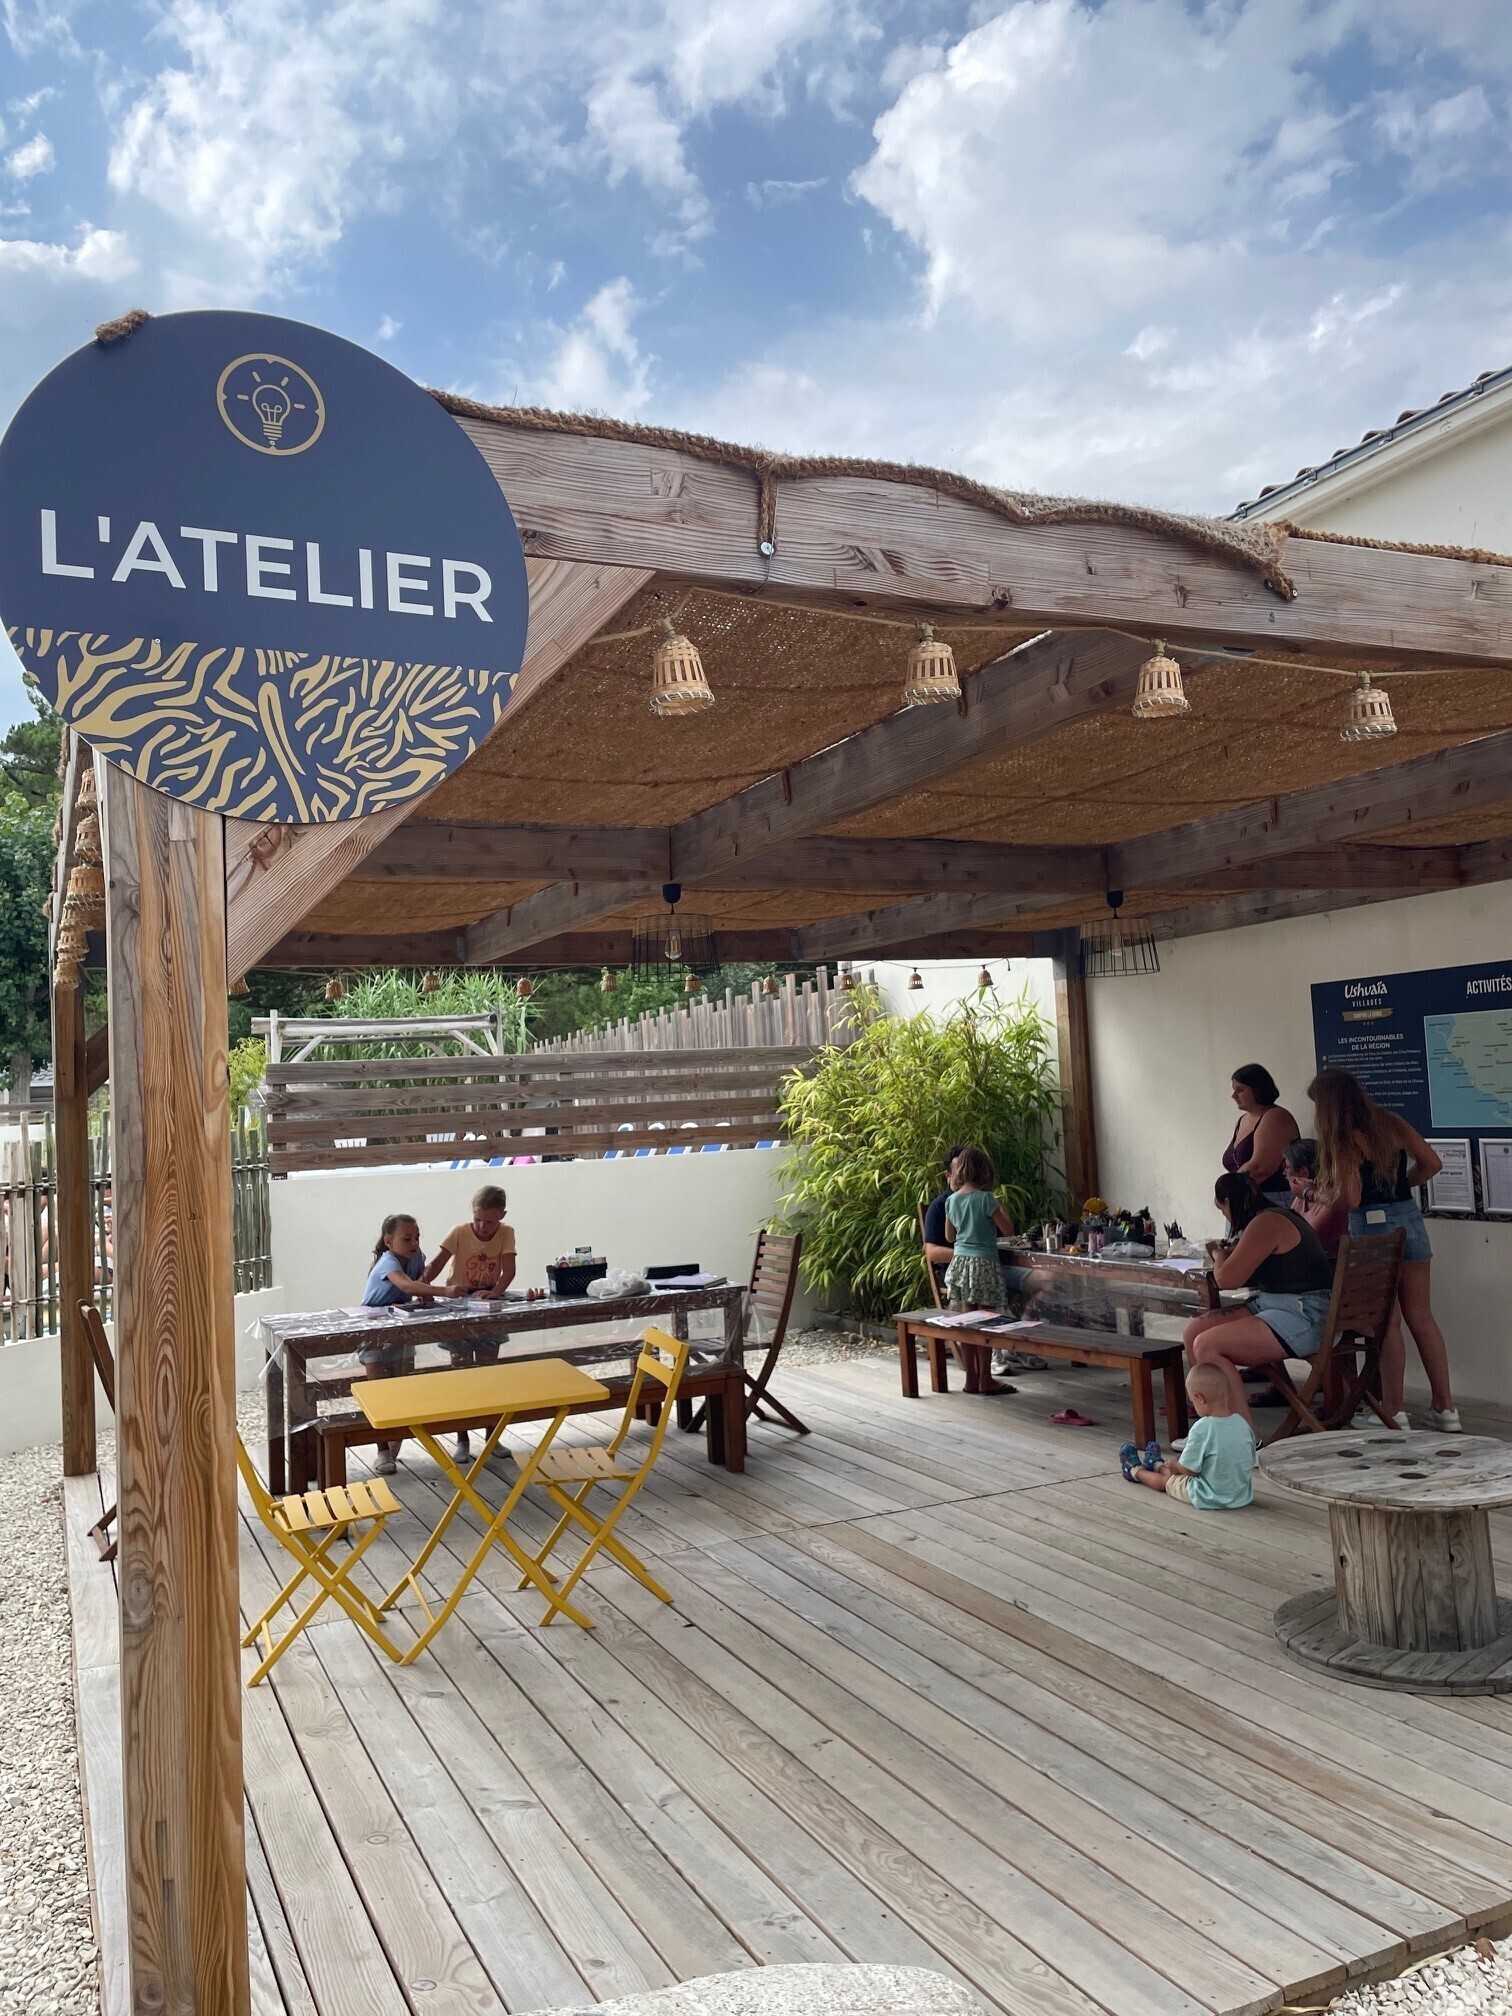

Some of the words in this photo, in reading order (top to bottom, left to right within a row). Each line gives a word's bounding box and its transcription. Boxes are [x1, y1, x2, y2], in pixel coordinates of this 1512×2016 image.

[40, 508, 494, 623] L'ATELIER
[1344, 981, 1388, 999] Ushuaïa
[1466, 974, 1512, 995] ACTIVITÉS
[1352, 998, 1382, 1008] VILLAGES
[1348, 1033, 1404, 1043] INCONTOURNABLES
